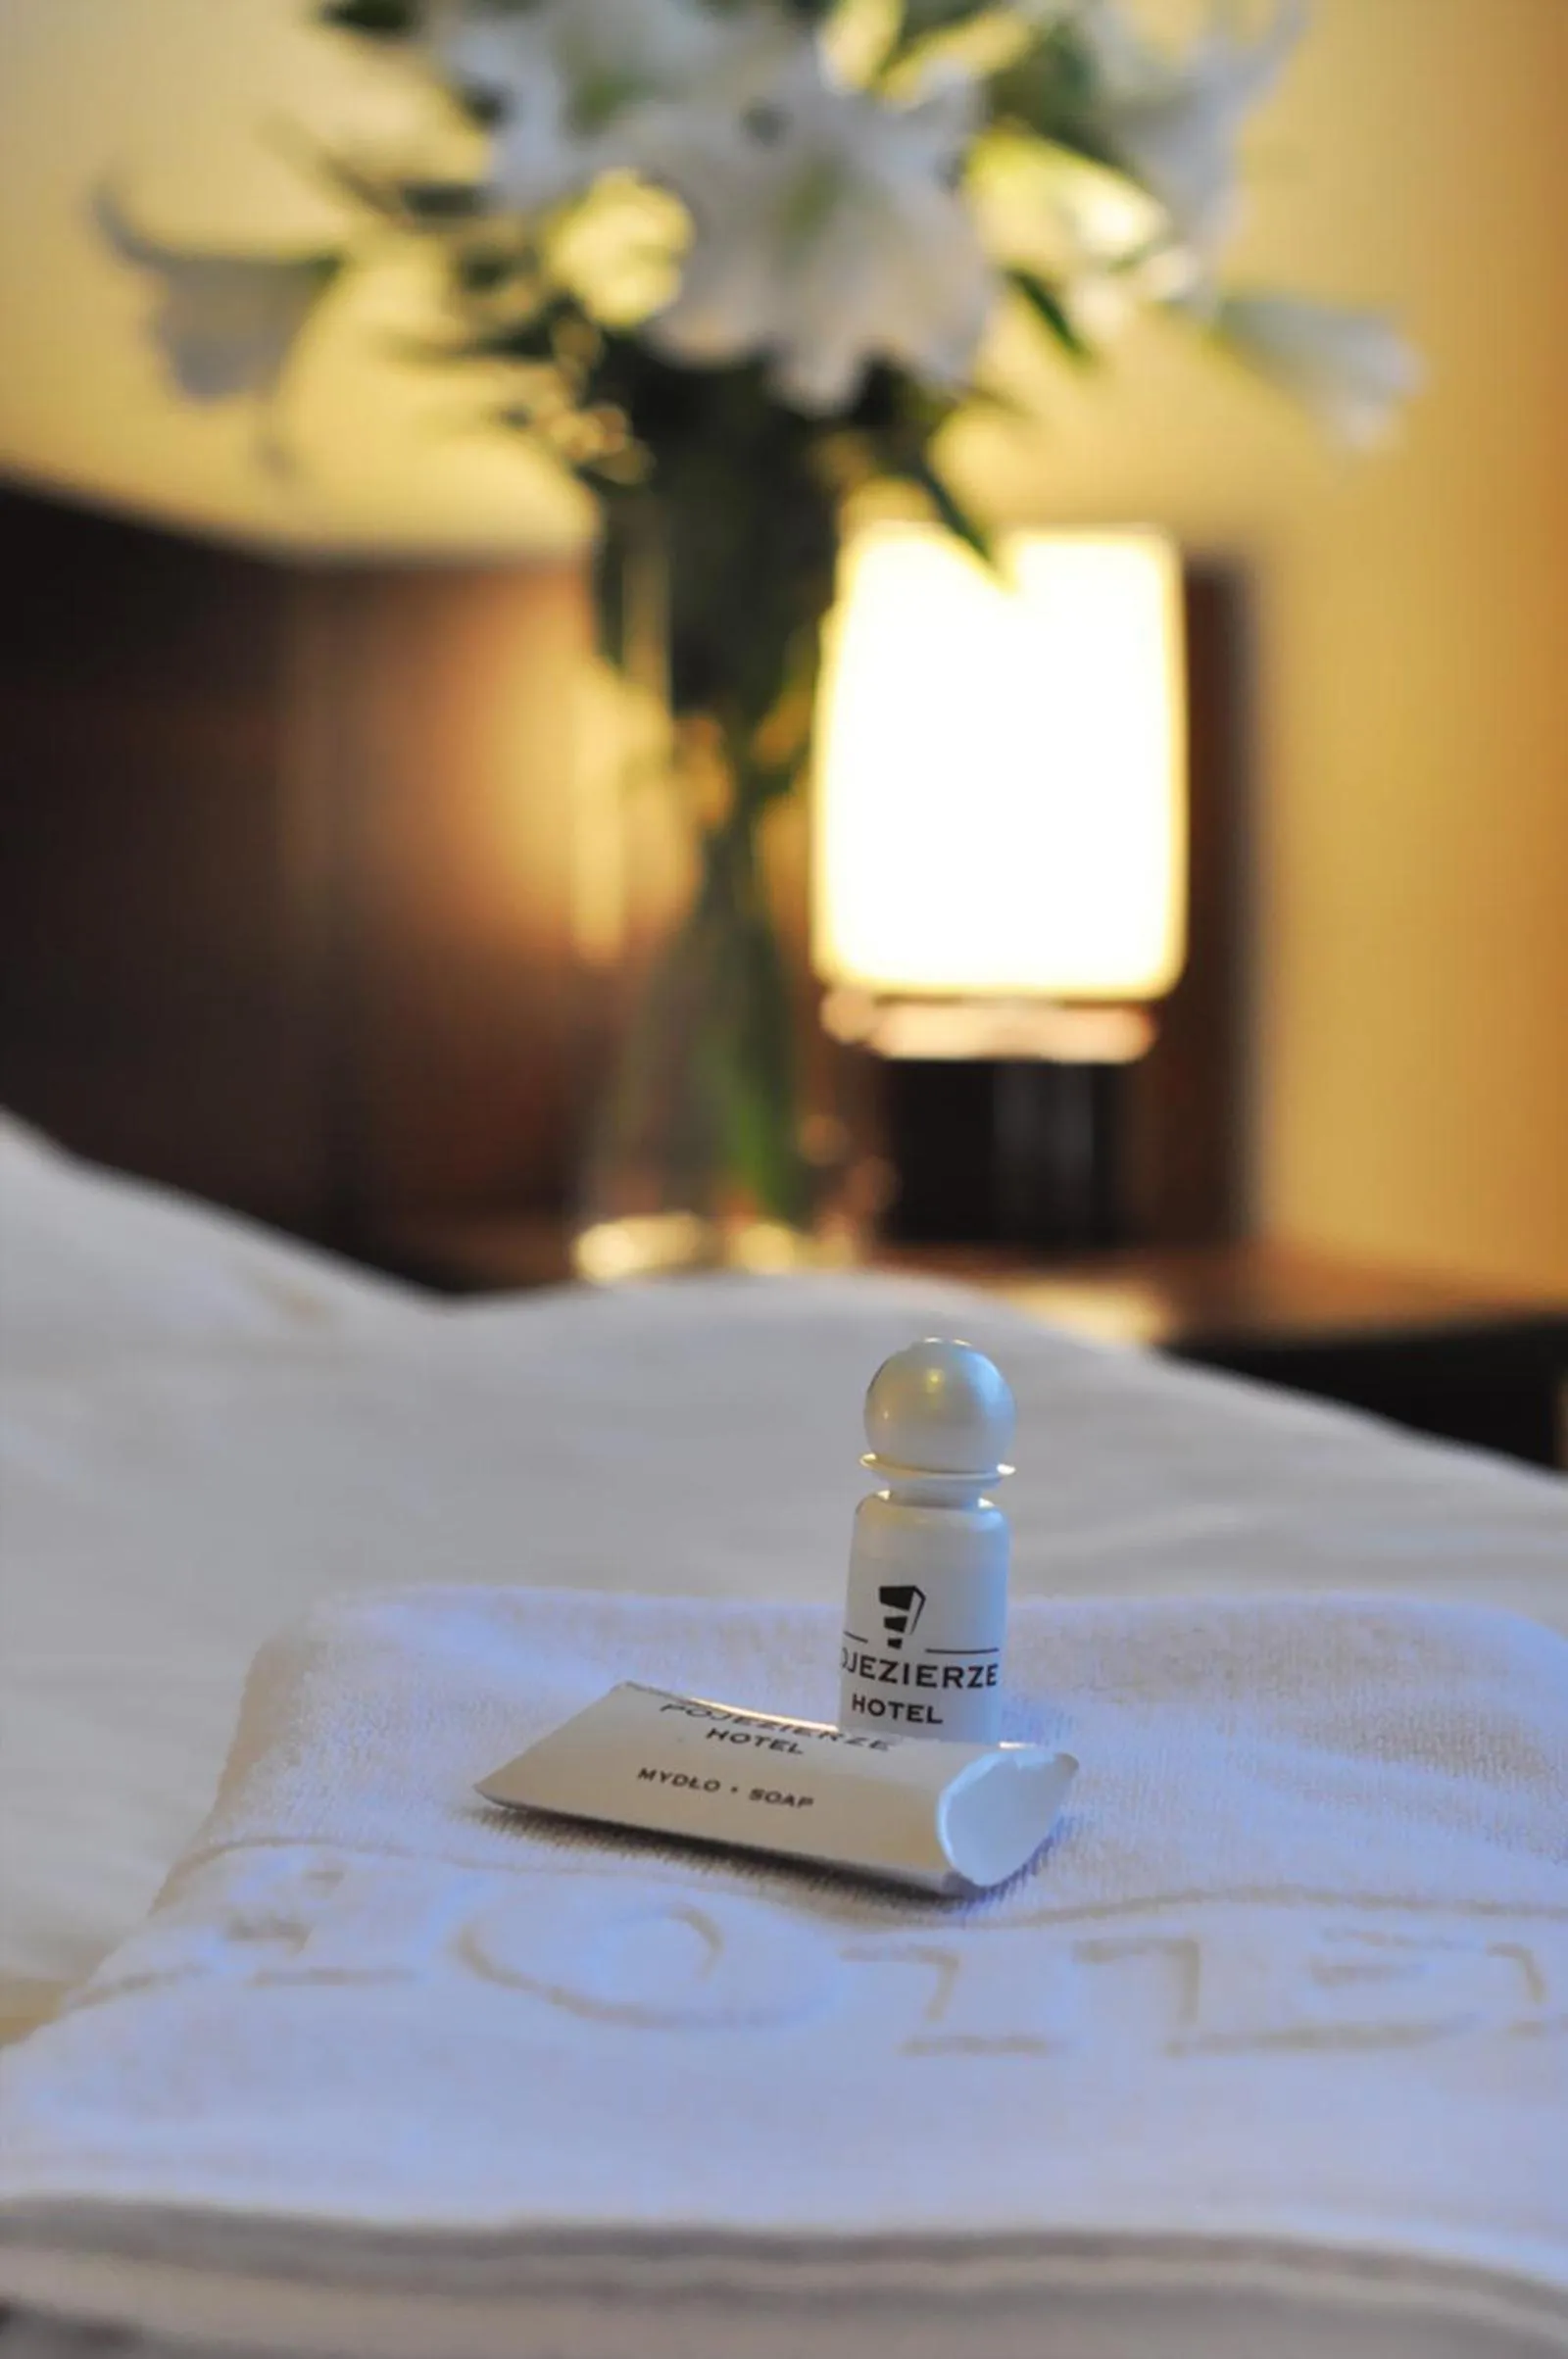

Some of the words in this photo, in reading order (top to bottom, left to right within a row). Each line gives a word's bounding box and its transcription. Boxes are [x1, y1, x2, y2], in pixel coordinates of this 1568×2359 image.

[852, 1693, 944, 1725] HOTEL
[706, 1727, 805, 1755] HOTEL
[637, 1767, 721, 1794] MYDŁO
[749, 1788, 815, 1809] SOAP
